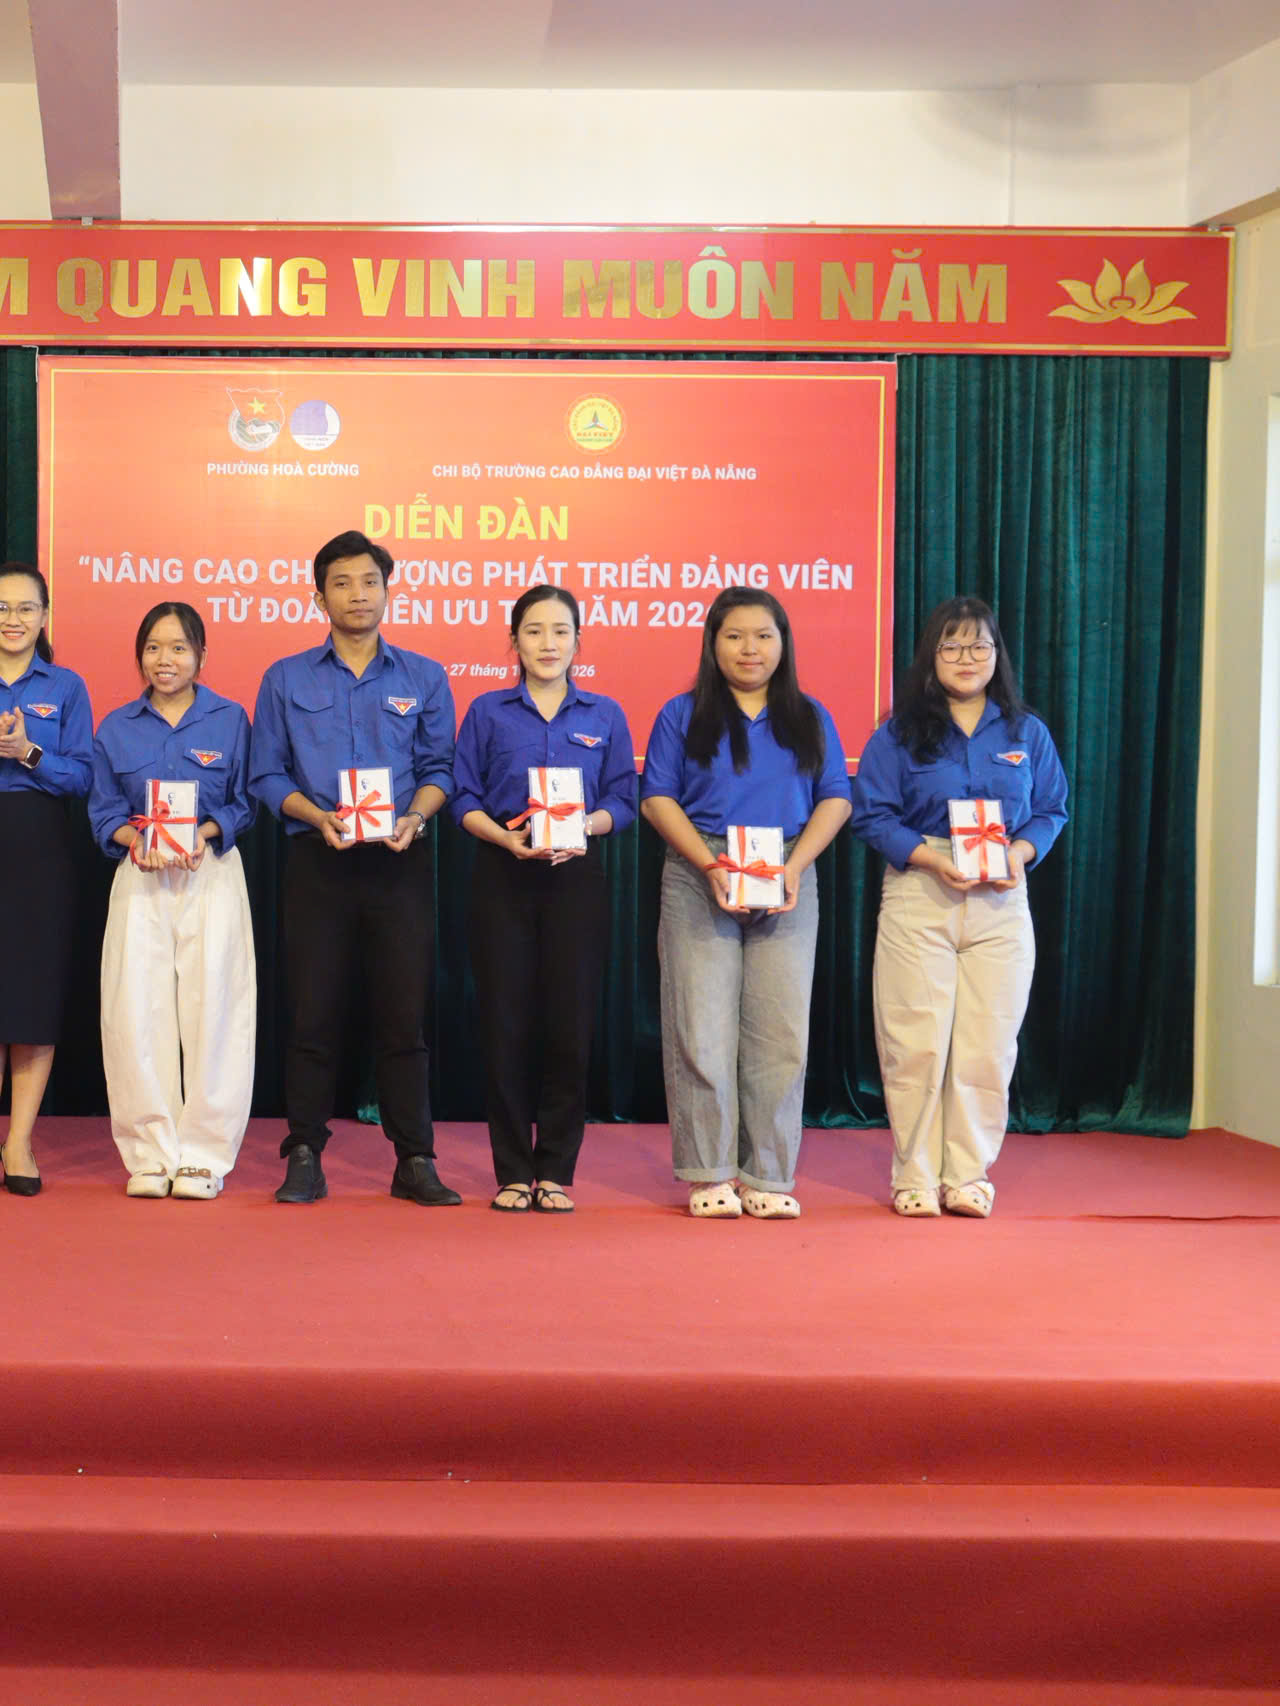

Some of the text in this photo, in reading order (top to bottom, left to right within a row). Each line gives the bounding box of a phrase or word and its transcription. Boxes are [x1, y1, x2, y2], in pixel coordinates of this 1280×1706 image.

[56, 257, 326, 323] QUANG
[352, 257, 536, 318] VINH
[562, 246, 793, 320] MUÔN
[820, 248, 1008, 324] NĂM
[207, 460, 359, 476] PHƯỜNG HOÀ CƯỜNG
[432, 465, 458, 478] CHI
[462, 462, 480, 480] BỘ
[485, 463, 545, 478] TRƯỜNG
[550, 466, 579, 478] CAO
[627, 466, 651, 481] ĐẠI
[656, 464, 688, 481] VIỆT
[691, 465, 711, 480] ĐÀ
[364, 493, 569, 541] DIỄN ĐÀN
[193, 558, 258, 585] CAO
[268, 559, 316, 585] CH
[387, 558, 472, 592] ƯỢNG
[483, 555, 568, 588] PHÁT
[577, 554, 671, 588] TRIỂN
[680, 554, 769, 589] ĐẢNG
[776, 557, 853, 590] VIÊN
[207, 591, 252, 623] TỪ
[259, 592, 331, 624] ĐOÀ
[382, 593, 433, 625] IÊN
[443, 599, 488, 626] ƯU
[648, 601, 710, 627] 202
[449, 663, 467, 676] 27
[470, 663, 508, 679] tháng
[571, 664, 595, 677] 026
